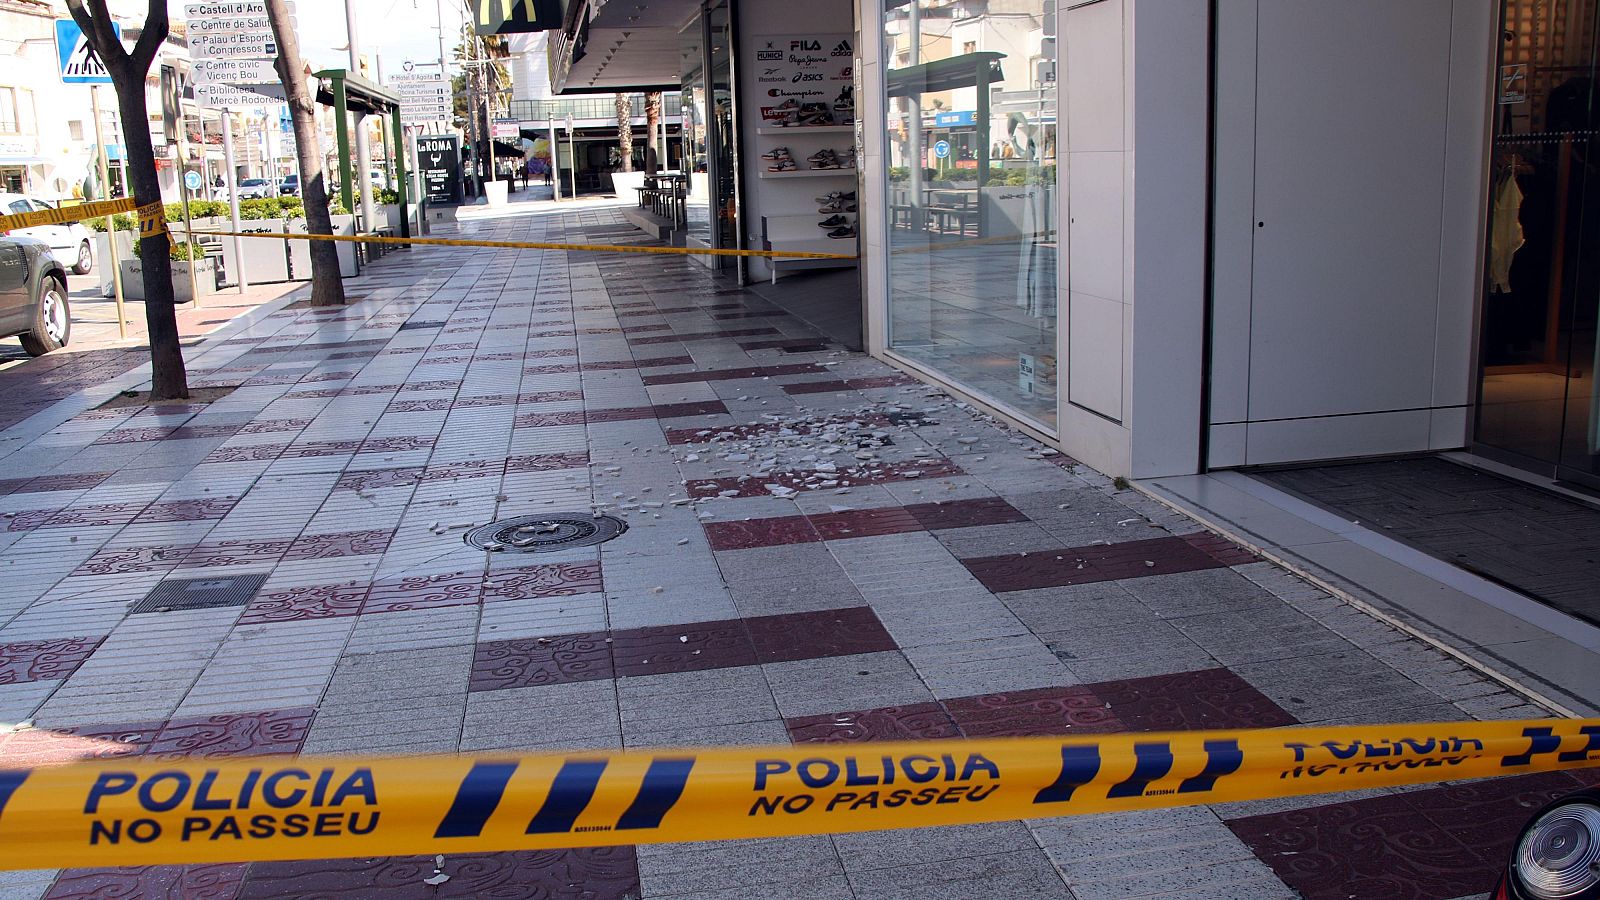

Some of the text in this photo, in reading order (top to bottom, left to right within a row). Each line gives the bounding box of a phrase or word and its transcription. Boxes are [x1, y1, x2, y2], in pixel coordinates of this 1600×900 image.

[200, 4, 263, 14] Castell d'Aro
[201, 18, 270, 30] Centre de Salut
[202, 34, 274, 44] Palau d'Esports
[203, 45, 262, 56] i Congressos
[790, 40, 822, 51] FILA
[206, 61, 236, 70] Centre
[206, 70, 258, 80] Vicenç Bou
[210, 86, 255, 94] Biblioteca
[768, 89, 824, 99] Champion
[210, 95, 285, 104] Mercè Rodoreda
[426, 140, 452, 151] ROMA
[138, 203, 160, 214] OLICIA
[753, 754, 1000, 791] POLICIA
[84, 768, 378, 814] POLICIA
[748, 784, 1000, 816] NO PASSEU
[90, 811, 380, 845] NO PASSEU
